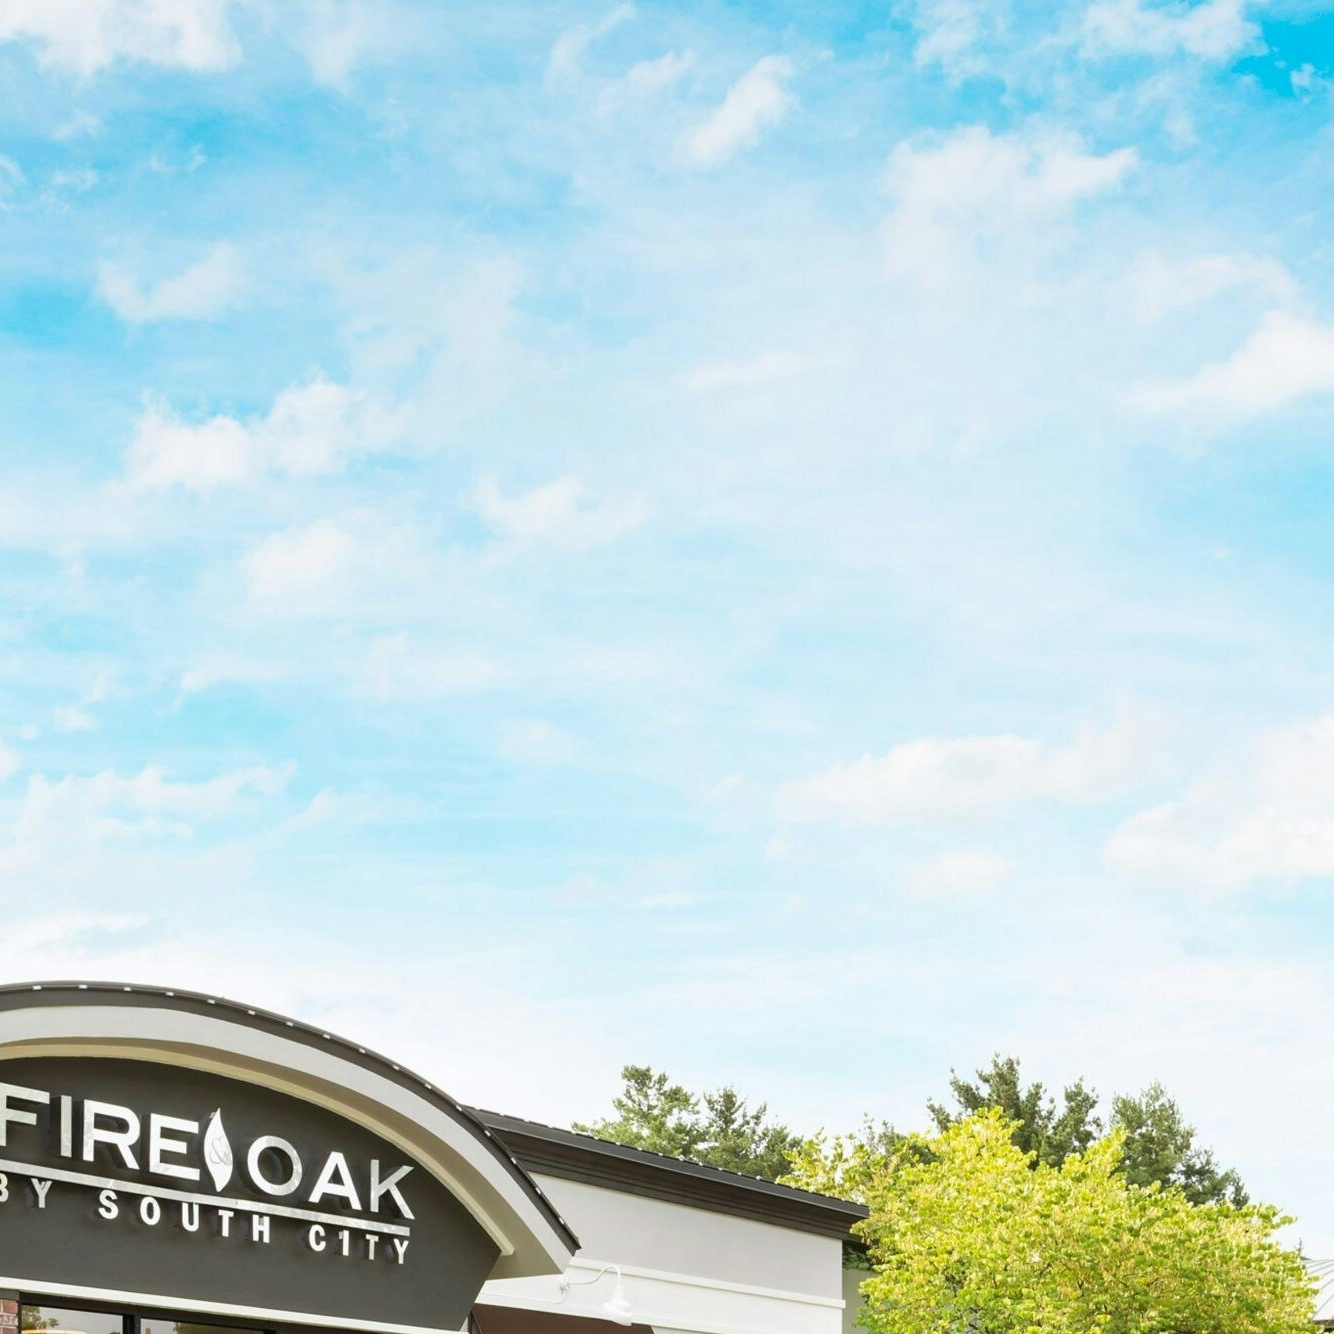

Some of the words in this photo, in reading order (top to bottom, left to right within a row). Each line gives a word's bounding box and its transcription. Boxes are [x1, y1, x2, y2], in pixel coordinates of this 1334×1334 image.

[246, 1135, 416, 1220] OAK
[98, 1190, 270, 1243] SOUTH
[308, 1224, 410, 1265] CITY
